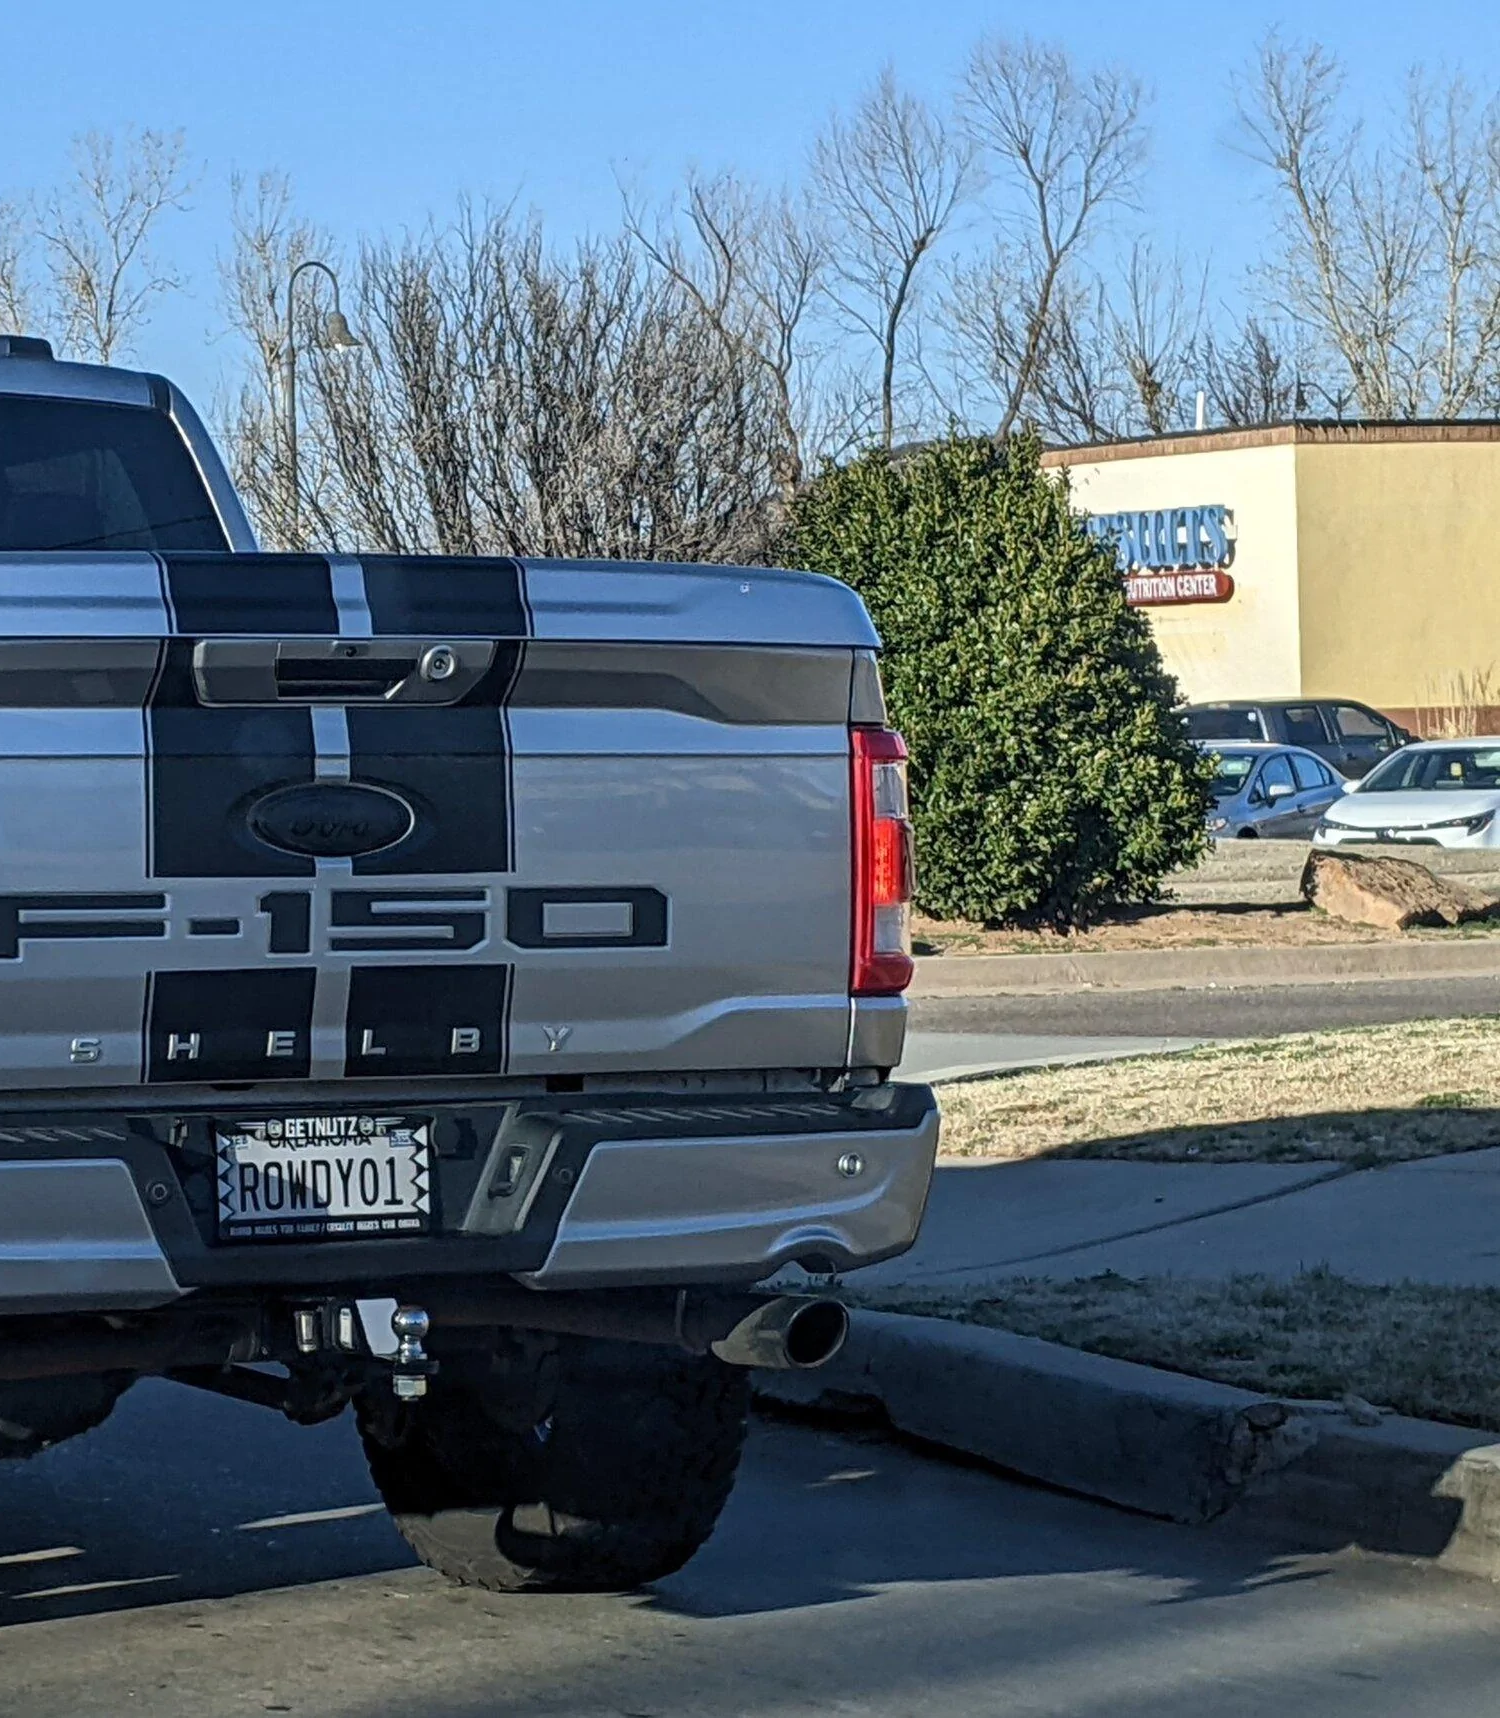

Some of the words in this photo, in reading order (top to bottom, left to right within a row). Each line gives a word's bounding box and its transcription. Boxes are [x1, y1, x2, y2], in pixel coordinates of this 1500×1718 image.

[1177, 574, 1217, 596] CENTER
[69, 1025, 573, 1063] SHELBY
[285, 1117, 358, 1137] GETNUTZ
[239, 1156, 403, 1212] ROWDY01
